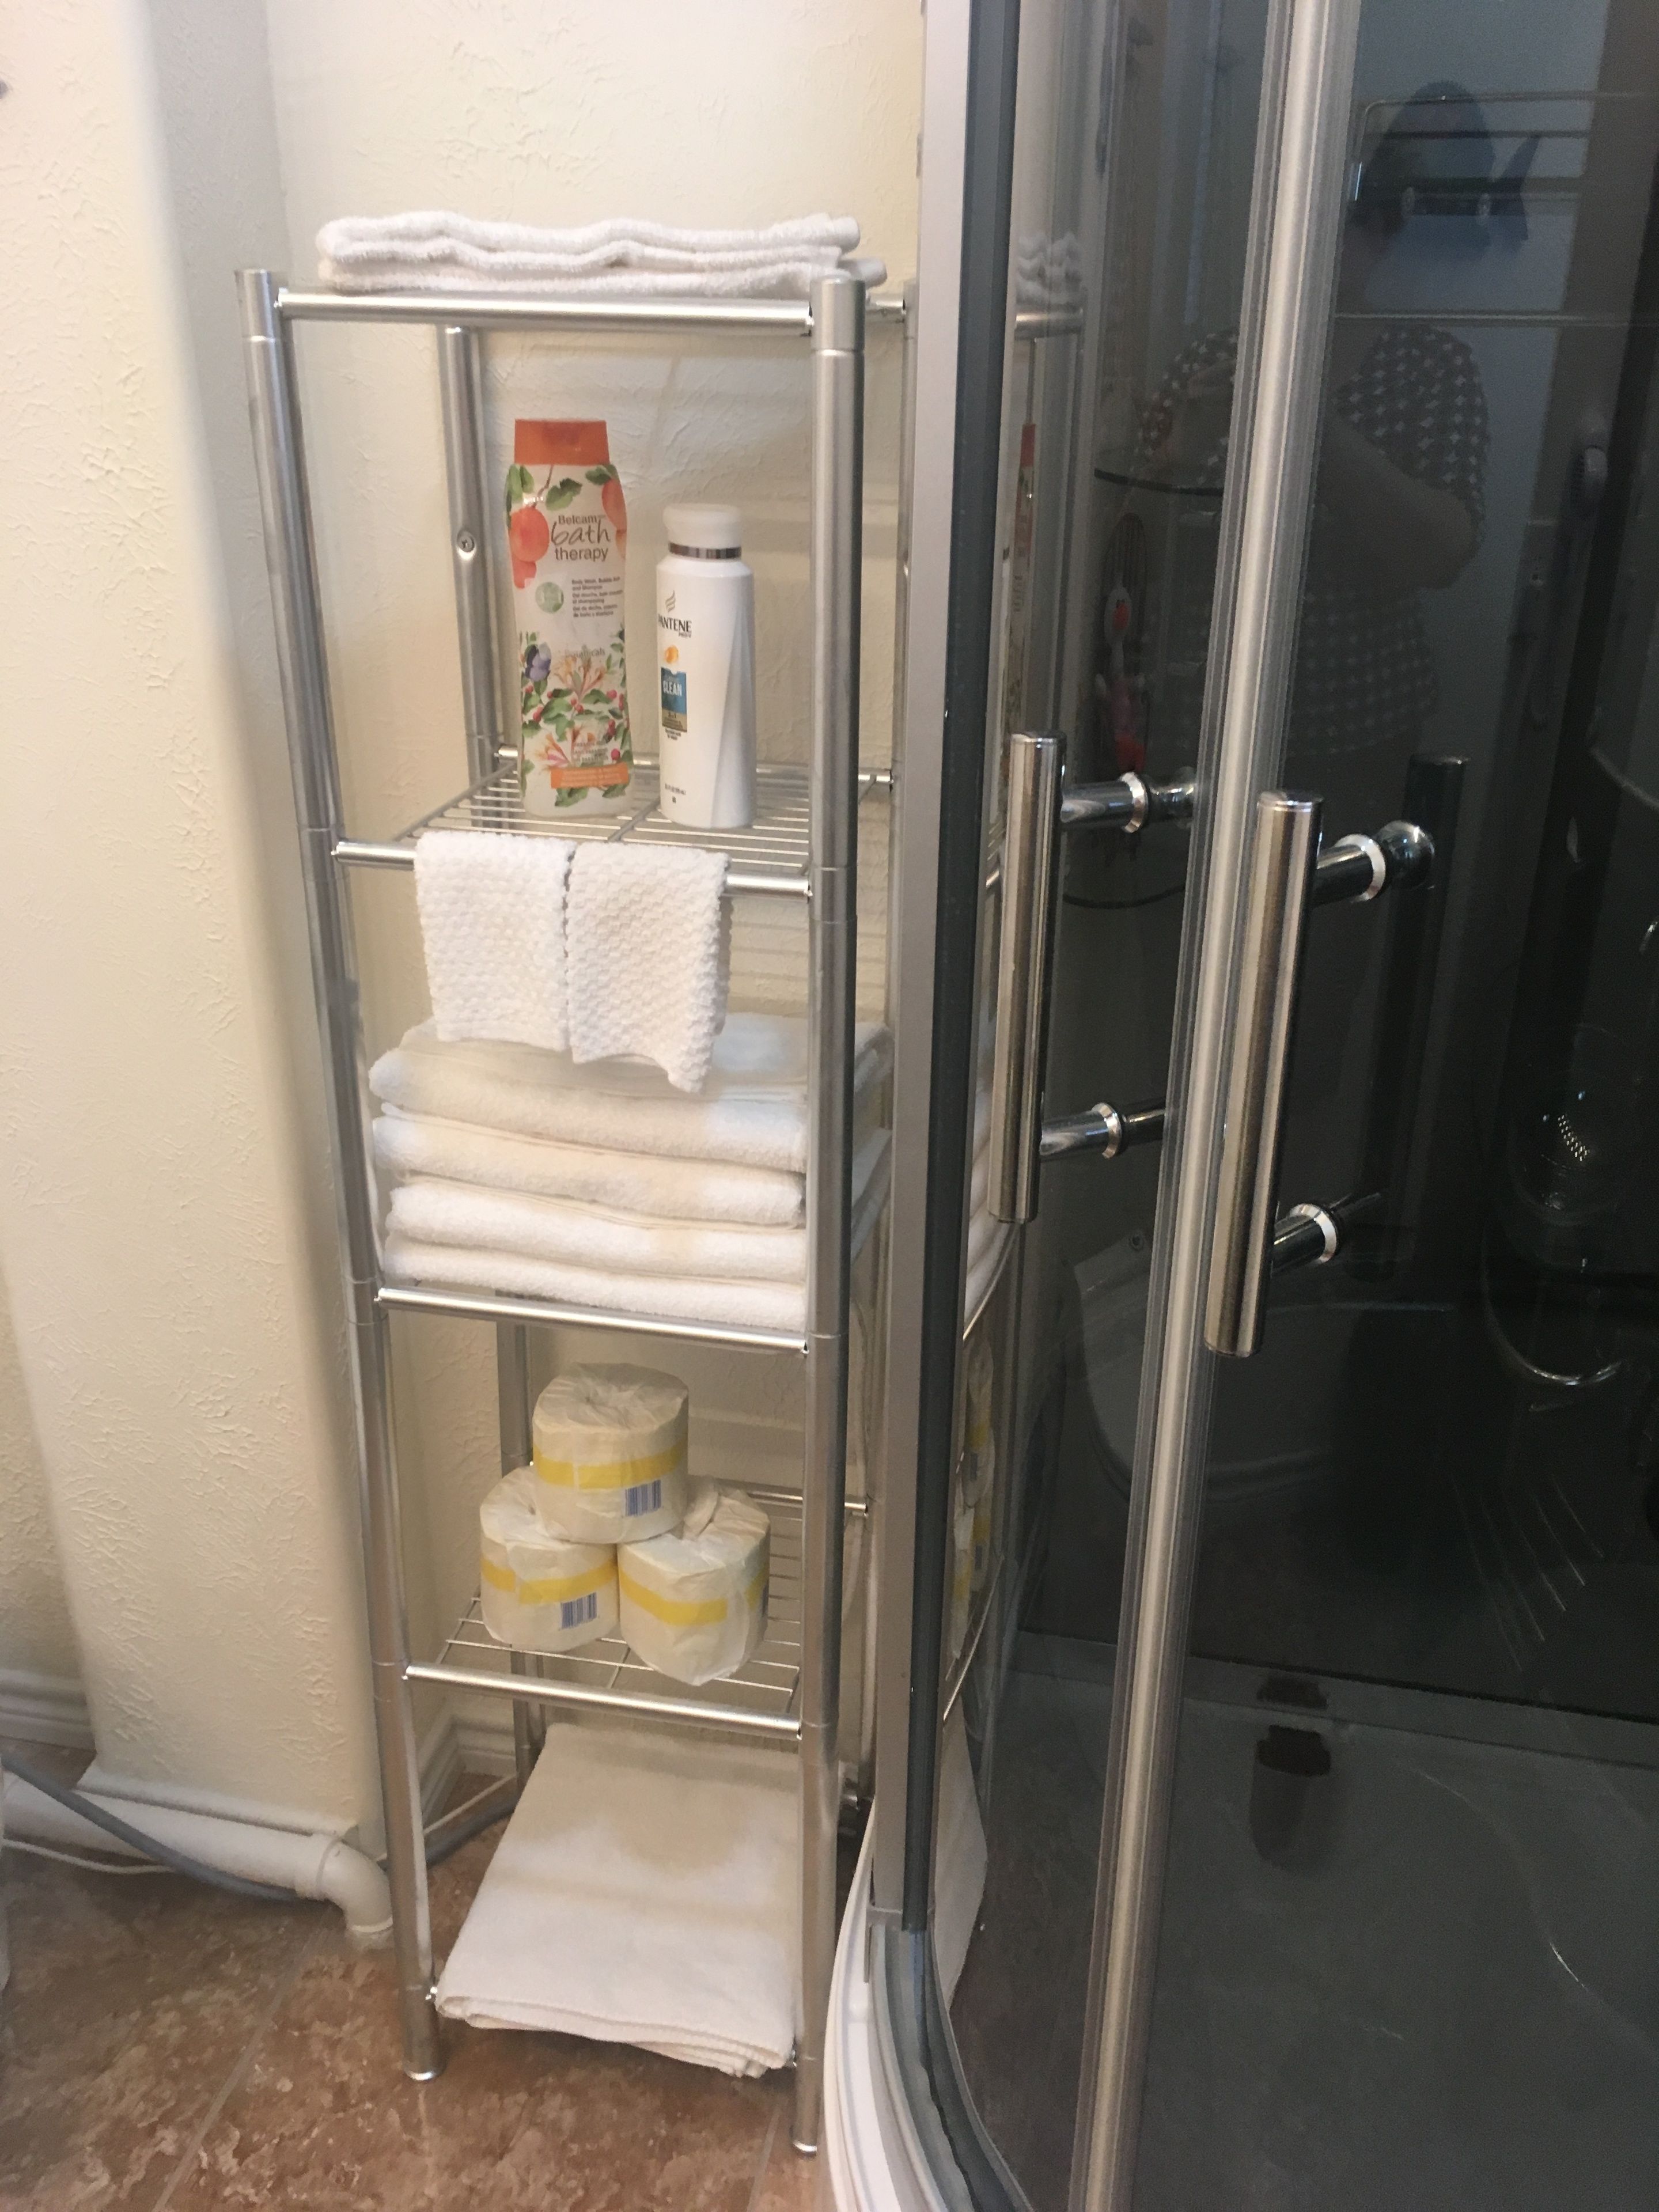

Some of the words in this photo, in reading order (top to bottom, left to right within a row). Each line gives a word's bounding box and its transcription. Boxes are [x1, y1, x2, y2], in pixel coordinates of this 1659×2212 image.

[558, 514, 597, 525] Belcam
[551, 519, 611, 546] bath
[555, 547, 608, 562] therapy
[658, 613, 692, 632] PANTENE
[662, 680, 683, 696] CLEAN
